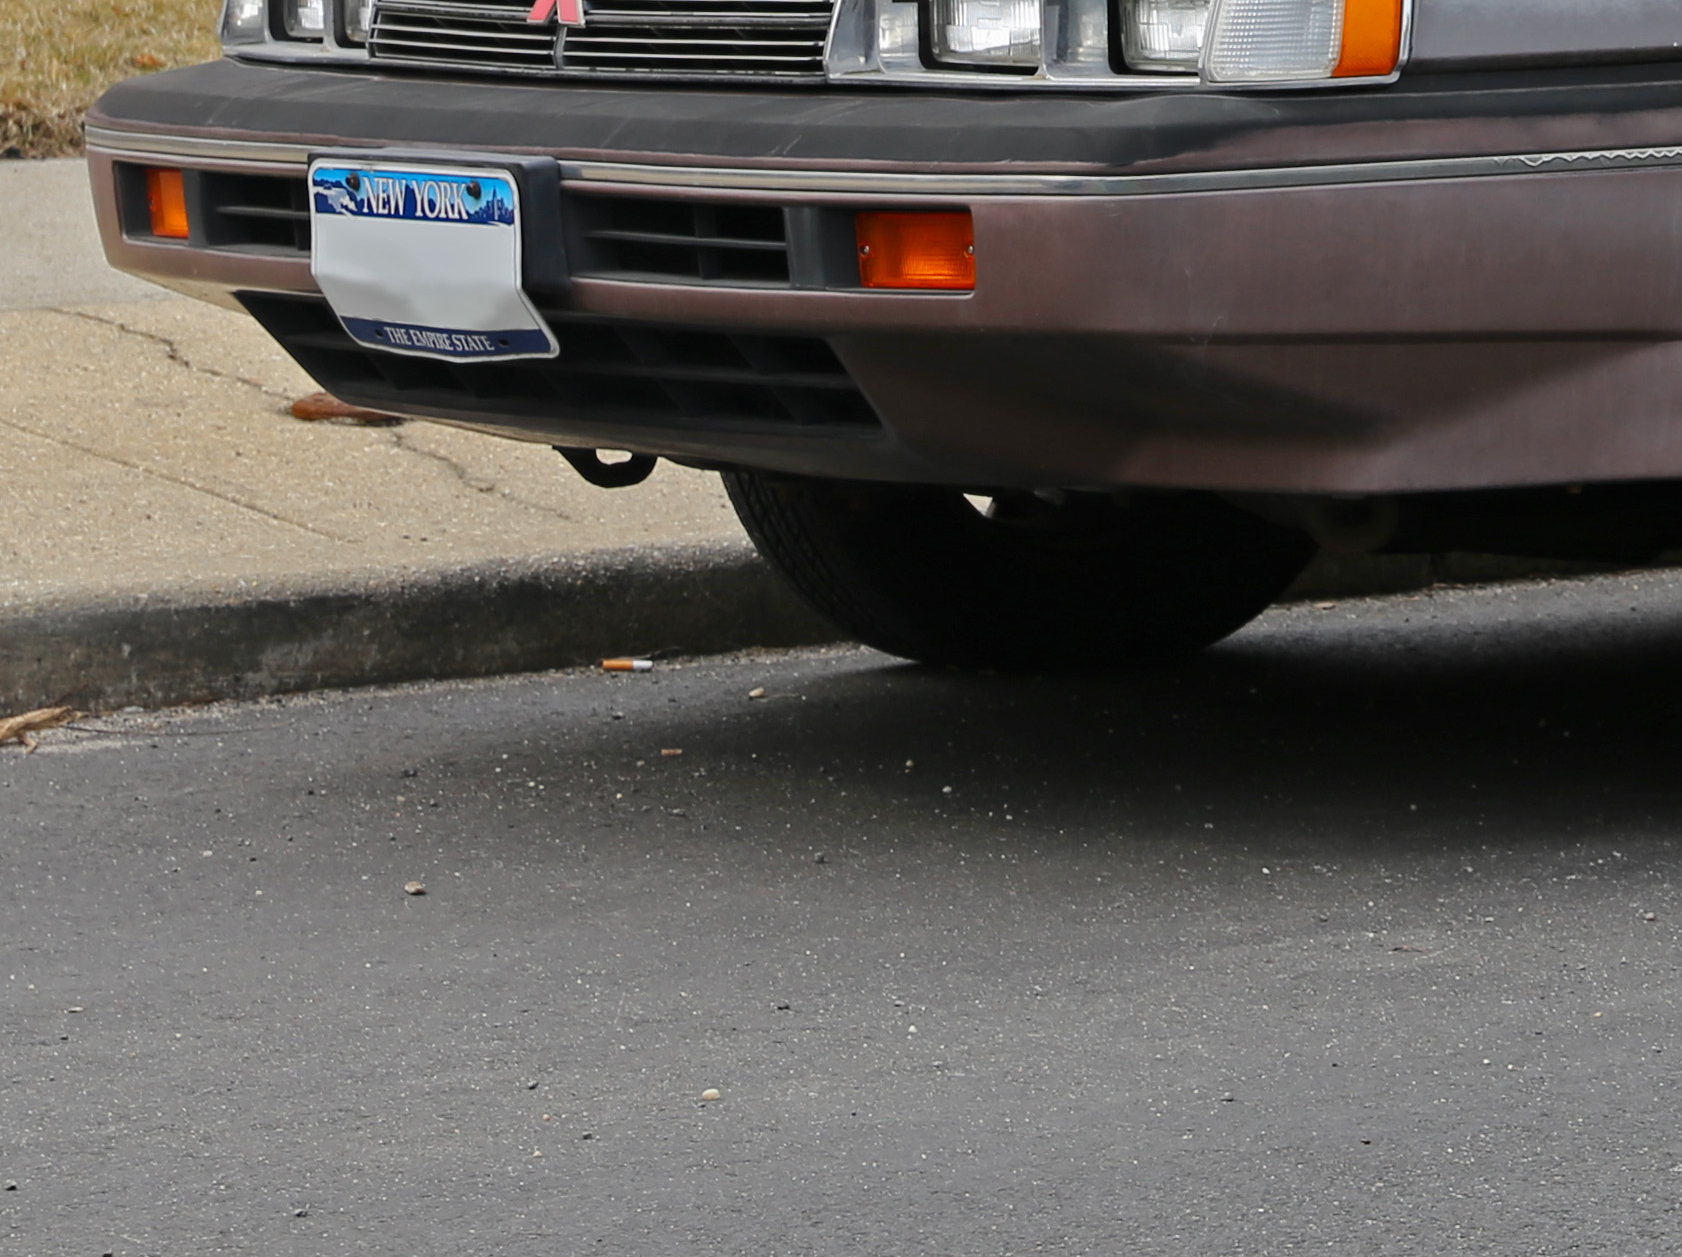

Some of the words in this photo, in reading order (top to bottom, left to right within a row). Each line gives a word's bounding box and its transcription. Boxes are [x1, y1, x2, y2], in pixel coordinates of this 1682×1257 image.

[362, 176, 406, 216] NEW
[411, 180, 468, 220] YORK
[383, 326, 409, 346] THE
[411, 329, 453, 350] EMPIRE
[453, 334, 495, 352] STATE
